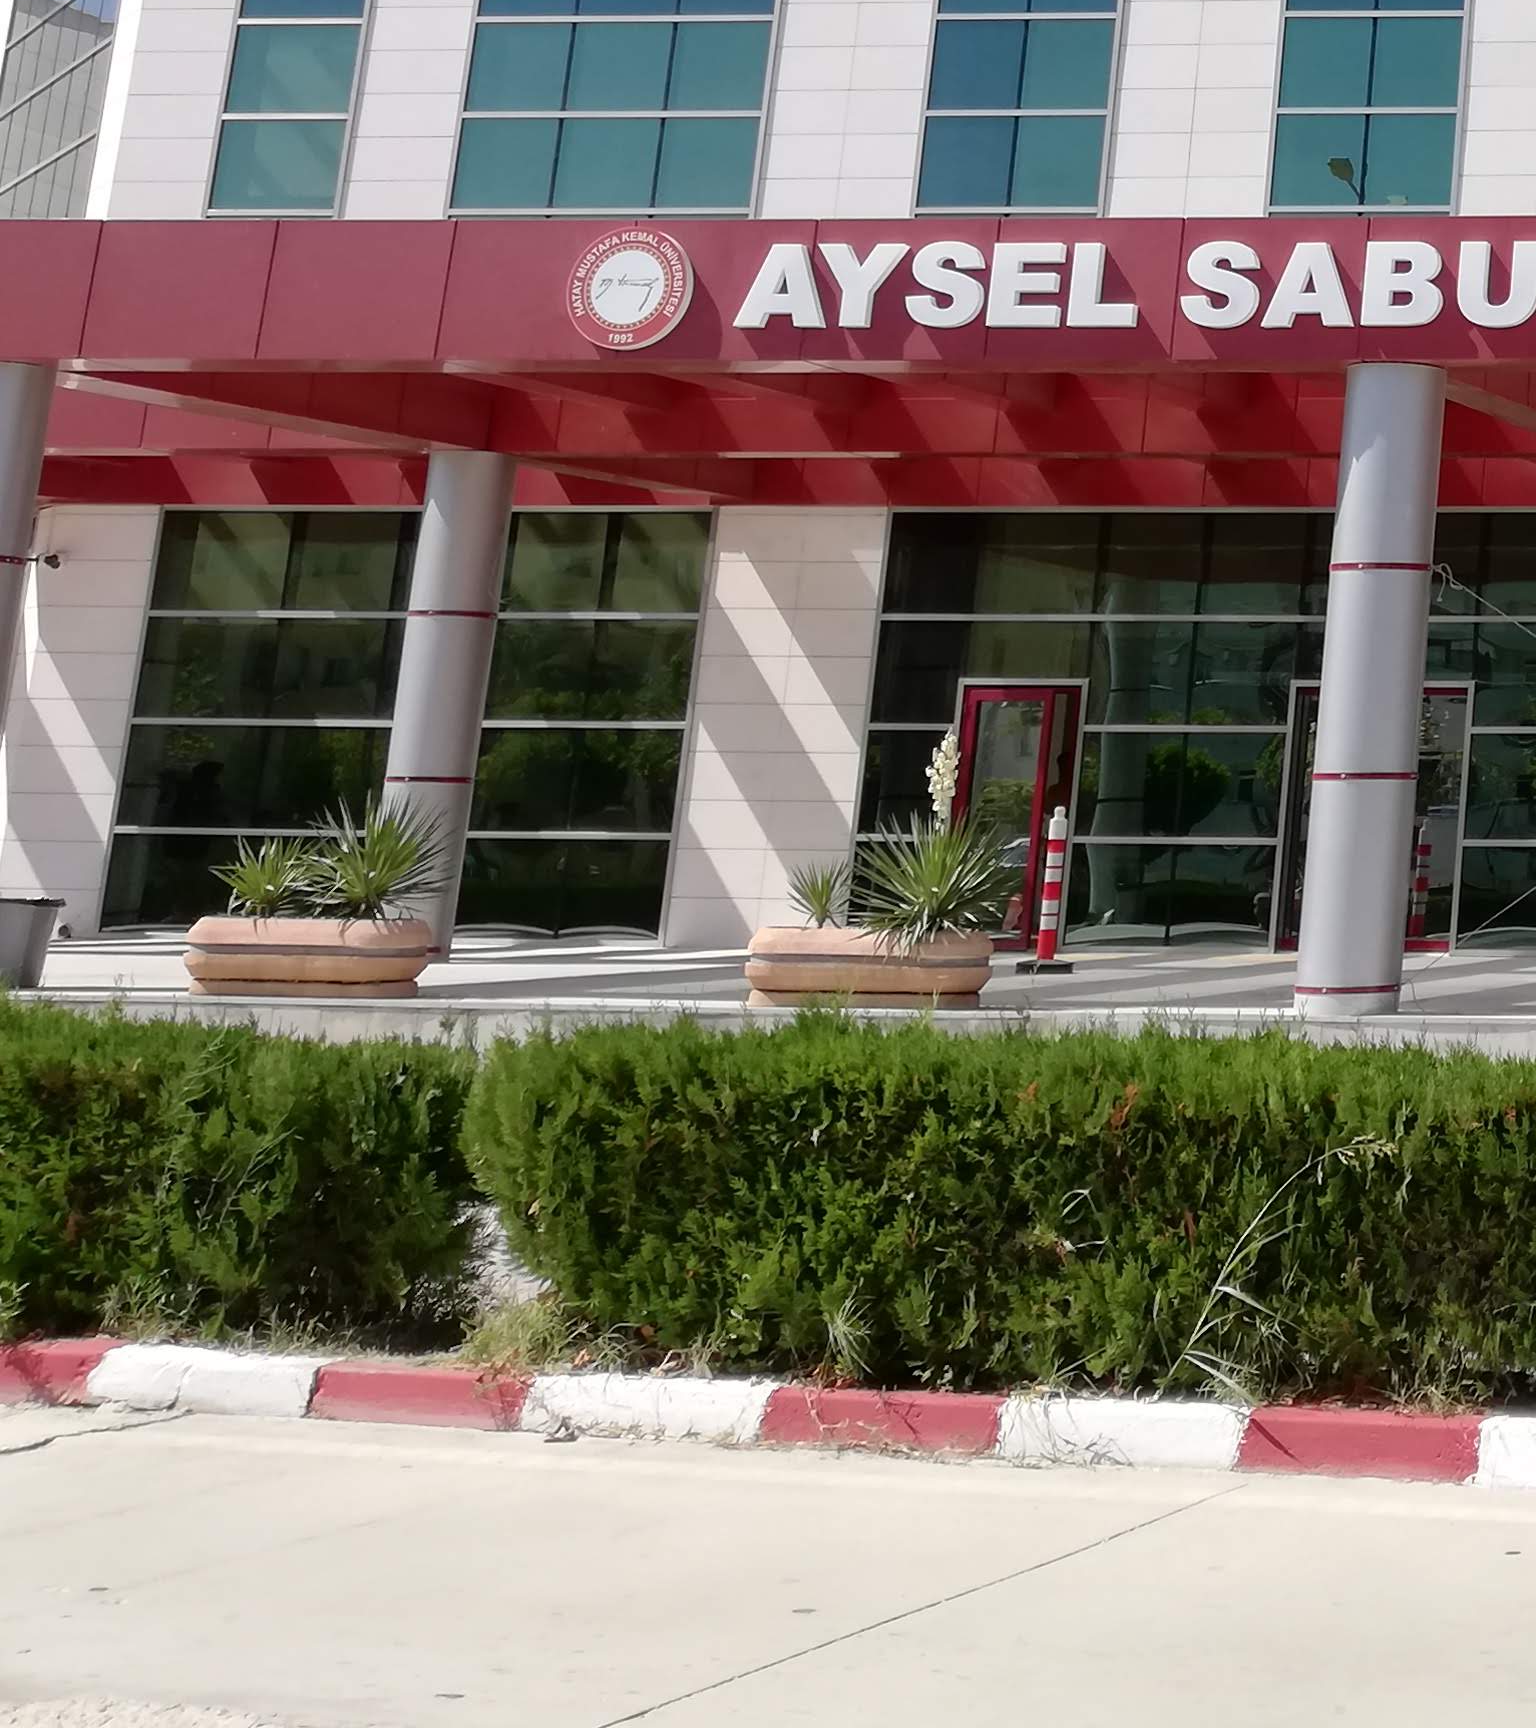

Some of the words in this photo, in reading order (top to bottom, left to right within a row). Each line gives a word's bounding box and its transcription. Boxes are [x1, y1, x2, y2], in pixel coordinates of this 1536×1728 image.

[576, 236, 621, 279] MUSTAFA
[621, 231, 661, 248] KEMAL
[571, 278, 587, 318] HATAY
[732, 239, 1138, 329] AYSEL
[607, 332, 635, 344] 1992
